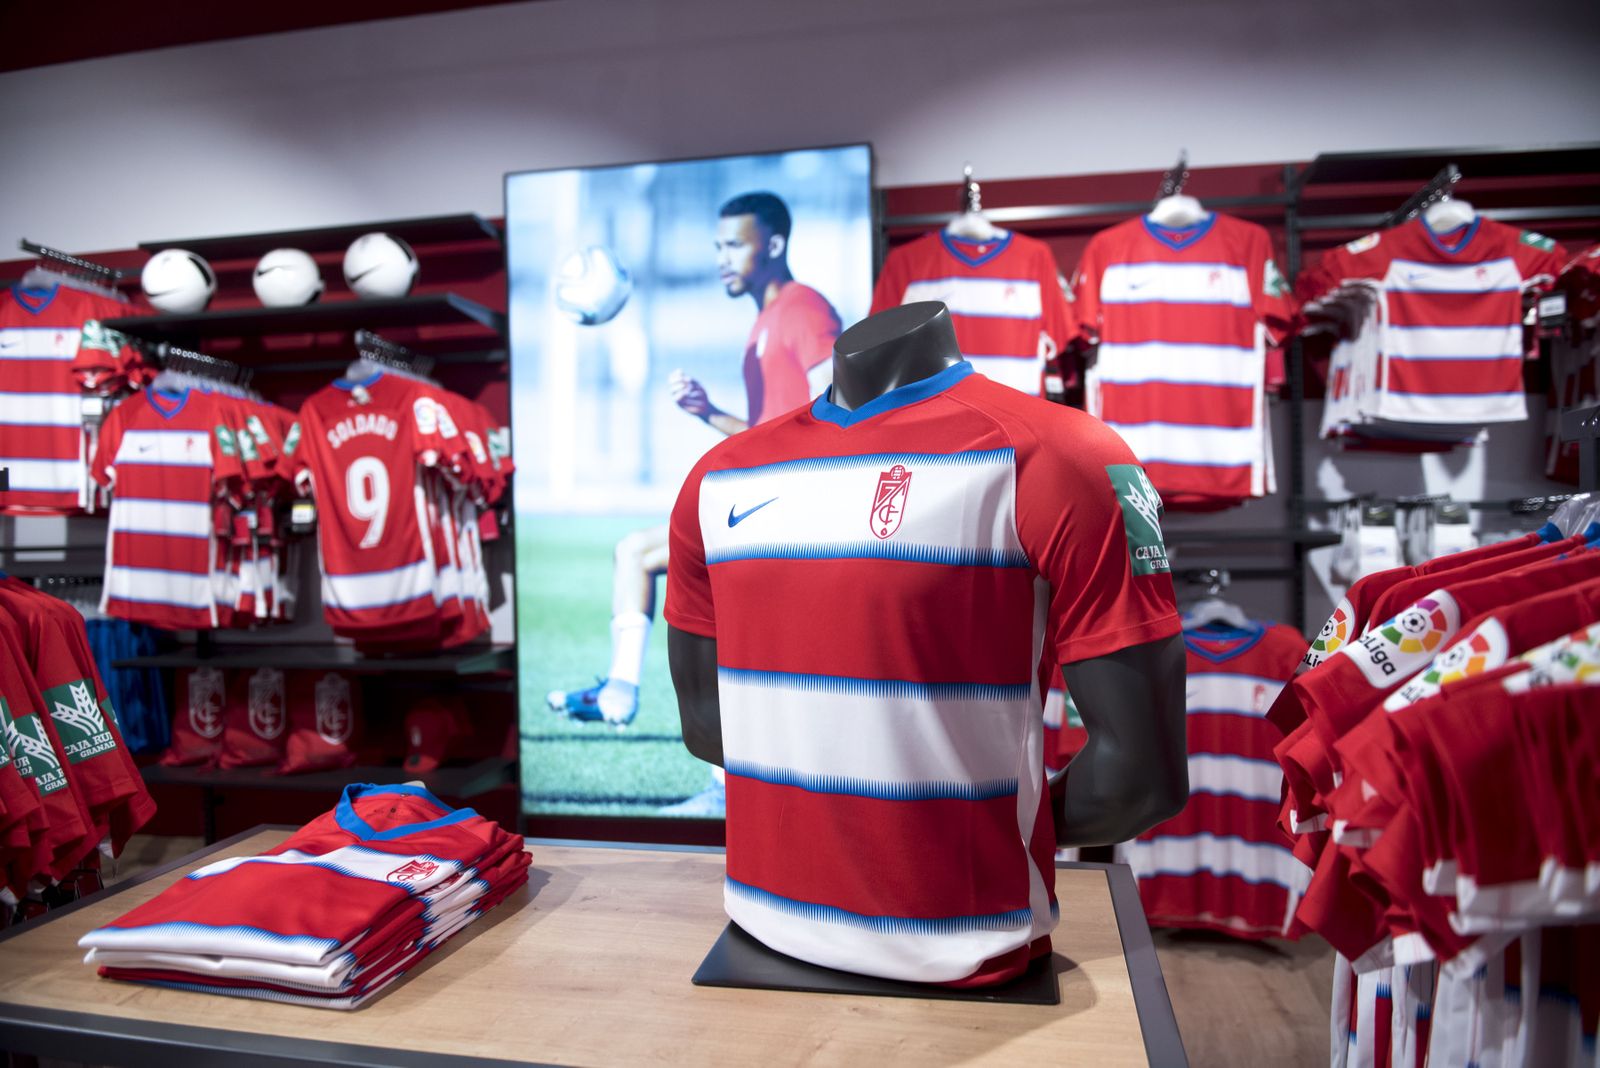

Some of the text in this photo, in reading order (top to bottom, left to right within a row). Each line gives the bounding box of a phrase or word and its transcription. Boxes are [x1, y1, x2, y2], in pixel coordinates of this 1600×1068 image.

[327, 413, 398, 449] SOLDADO
[346, 456, 390, 549] 9
[1135, 545, 1162, 560] CAJA
[64, 740, 92, 756] CAJA
